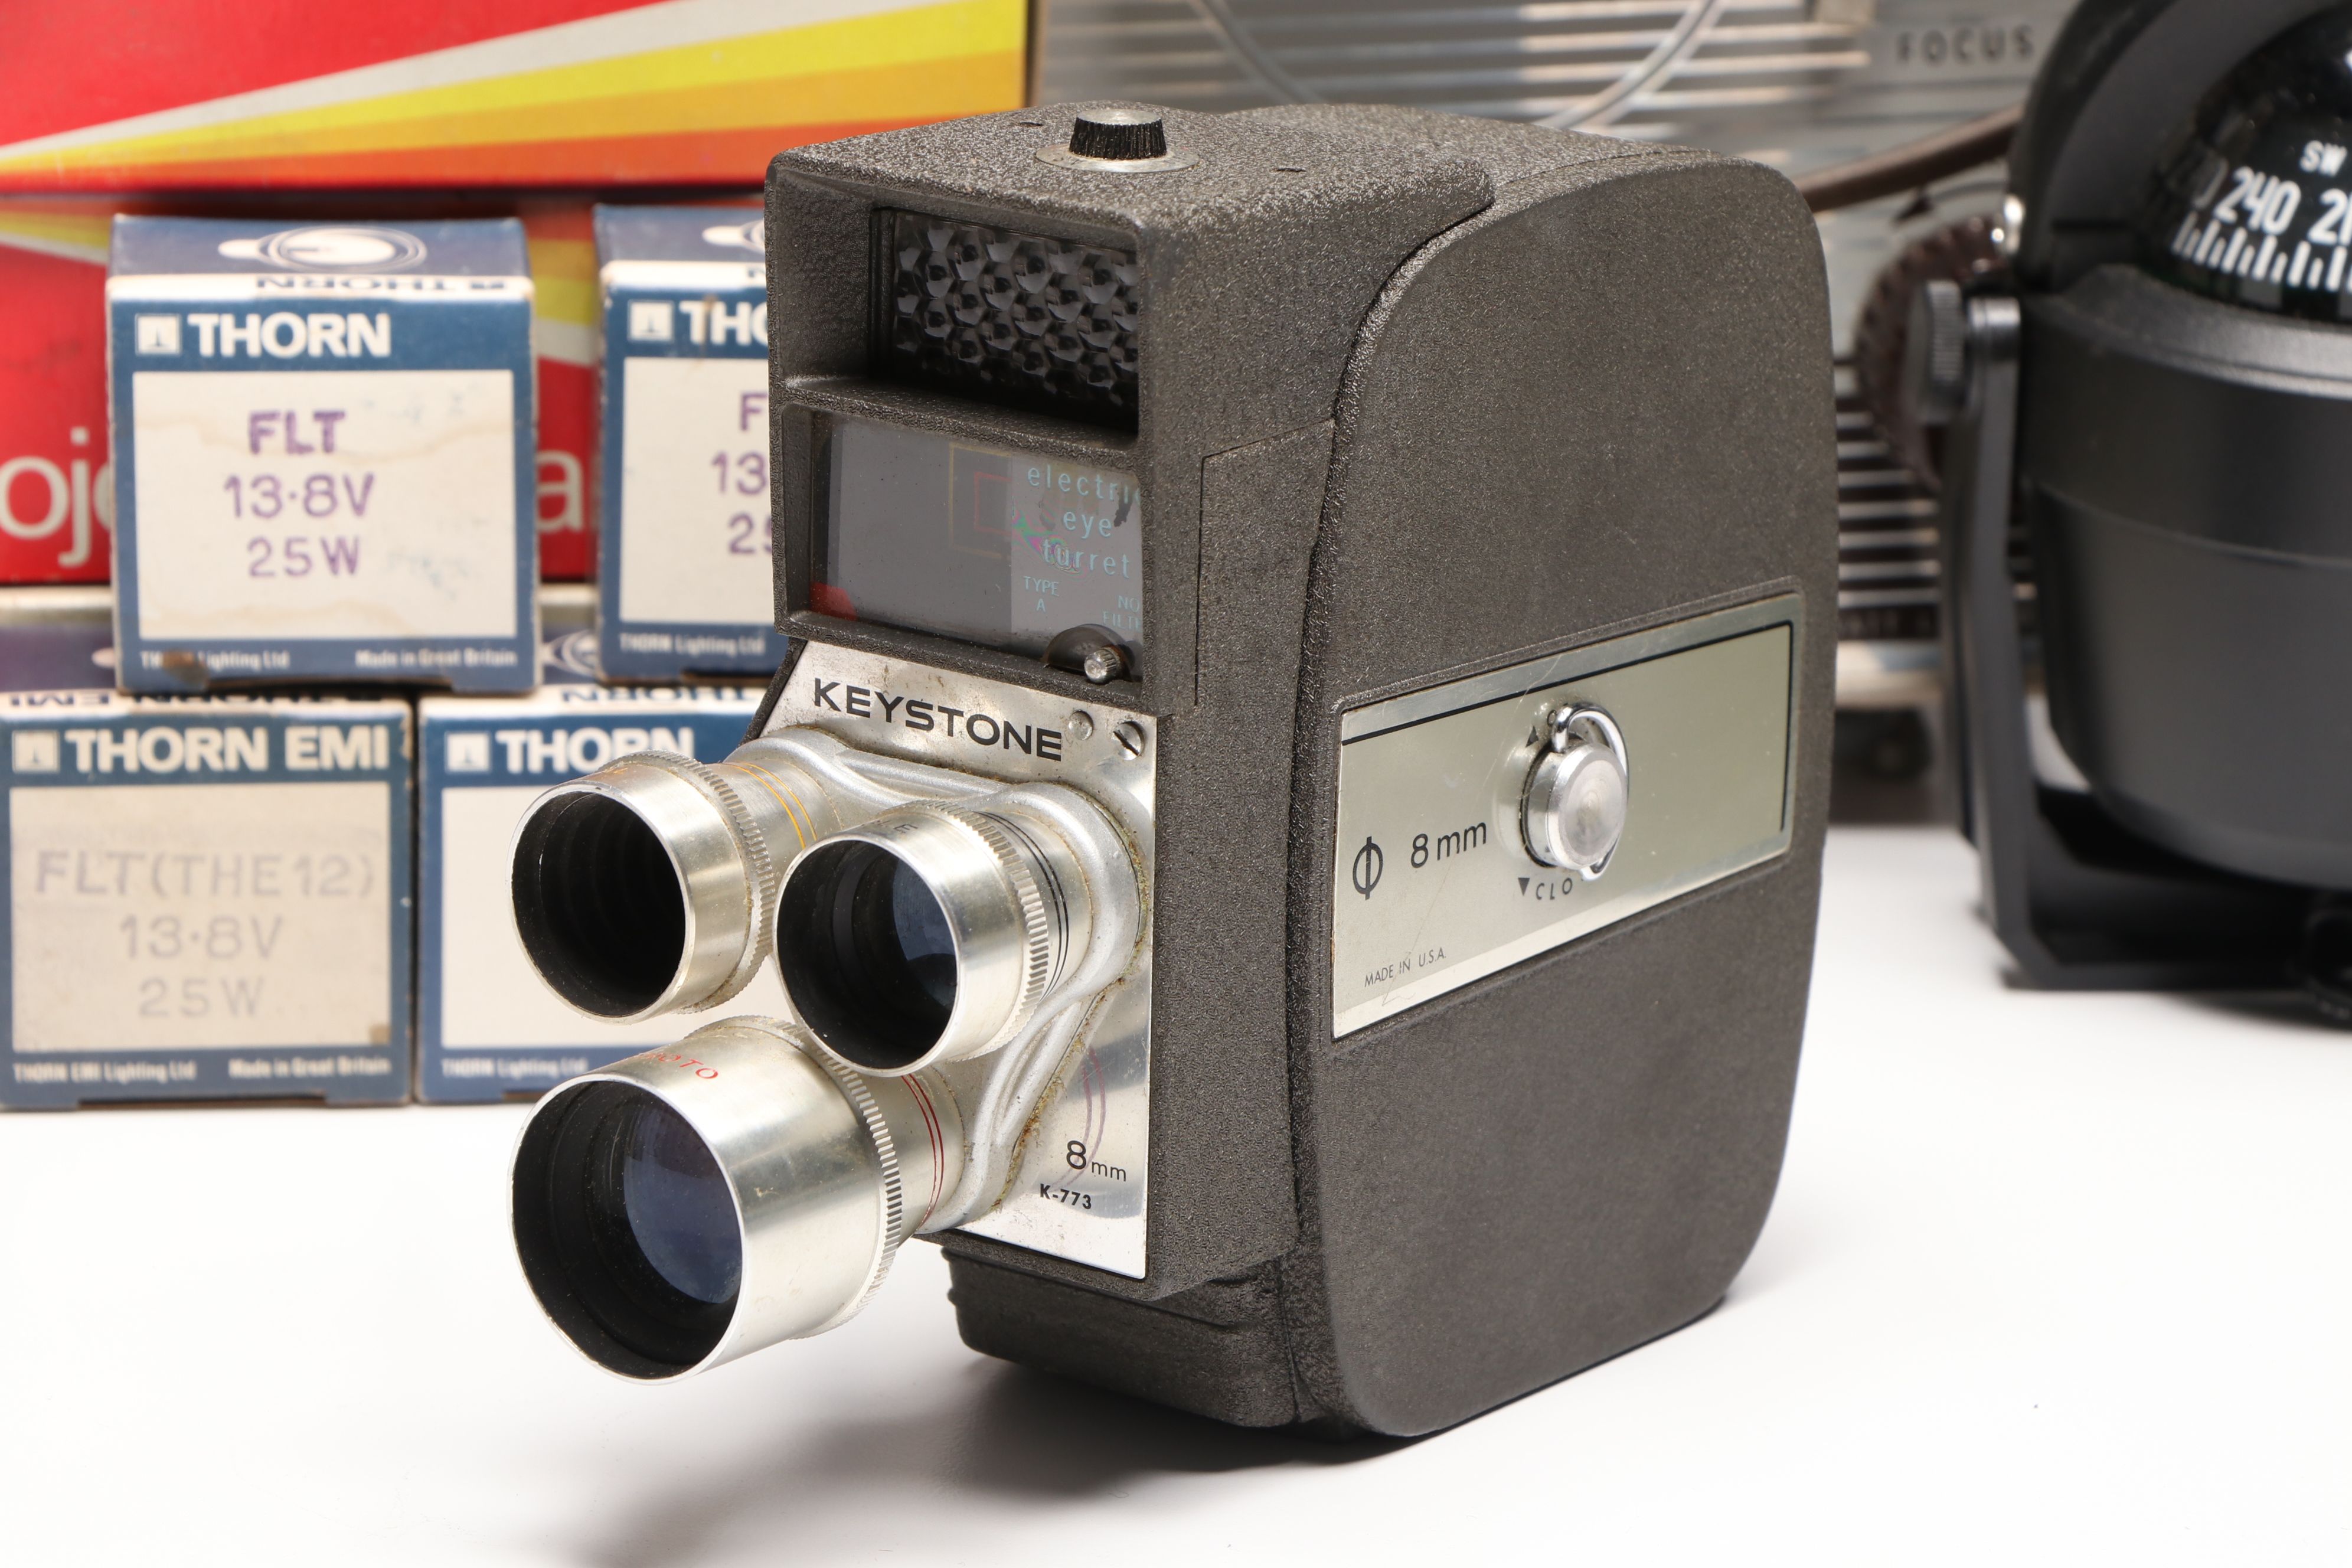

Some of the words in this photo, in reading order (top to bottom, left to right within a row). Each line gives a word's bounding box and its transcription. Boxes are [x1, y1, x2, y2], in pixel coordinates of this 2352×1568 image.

[1894, 25, 2035, 65] FOCUS
[2300, 141, 2348, 177] SW
[2214, 166, 2301, 236] 240
[187, 312, 391, 358] THORN
[247, 410, 345, 455] FLT
[0, 426, 110, 570] oj
[1063, 511, 1112, 540] eye
[1043, 538, 1130, 579] turret
[1023, 576, 1060, 597] TYPE
[1036, 597, 1047, 613] A
[1118, 594, 1141, 613] NO
[263, 650, 290, 669] Ltd
[355, 649, 397, 668] Made
[418, 649, 462, 668] Great
[464, 647, 518, 668] Britain
[814, 678, 1062, 762] KEYSTONE
[64, 726, 269, 773] THORN
[284, 725, 390, 769] EMI
[1364, 964, 1394, 988] MADE
[1399, 958, 1410, 974] IN
[1419, 946, 1447, 968] U.S.A.
[1040, 1183, 1092, 1210] K-773
